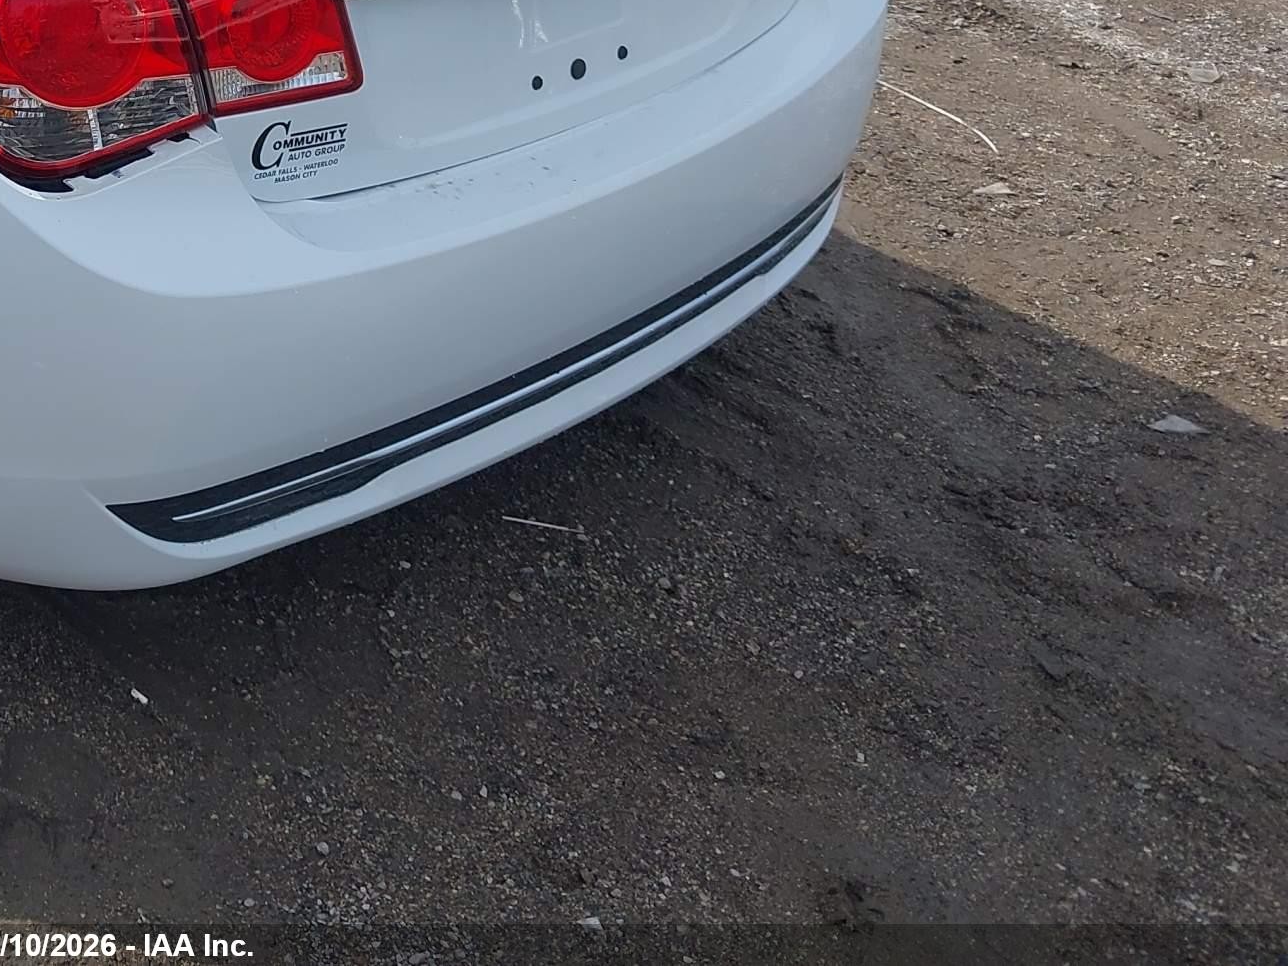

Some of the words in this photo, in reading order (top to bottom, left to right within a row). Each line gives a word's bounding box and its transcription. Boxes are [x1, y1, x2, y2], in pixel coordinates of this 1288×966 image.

[252, 120, 347, 170] COMMUNITY
[288, 150, 312, 162] AUTO
[314, 143, 346, 157] GROUP
[254, 170, 277, 180] CEDAR
[278, 166, 298, 175] FALLS
[303, 158, 339, 171] WATERLOO
[274, 173, 301, 184] MASON
[302, 170, 318, 179] CITY
